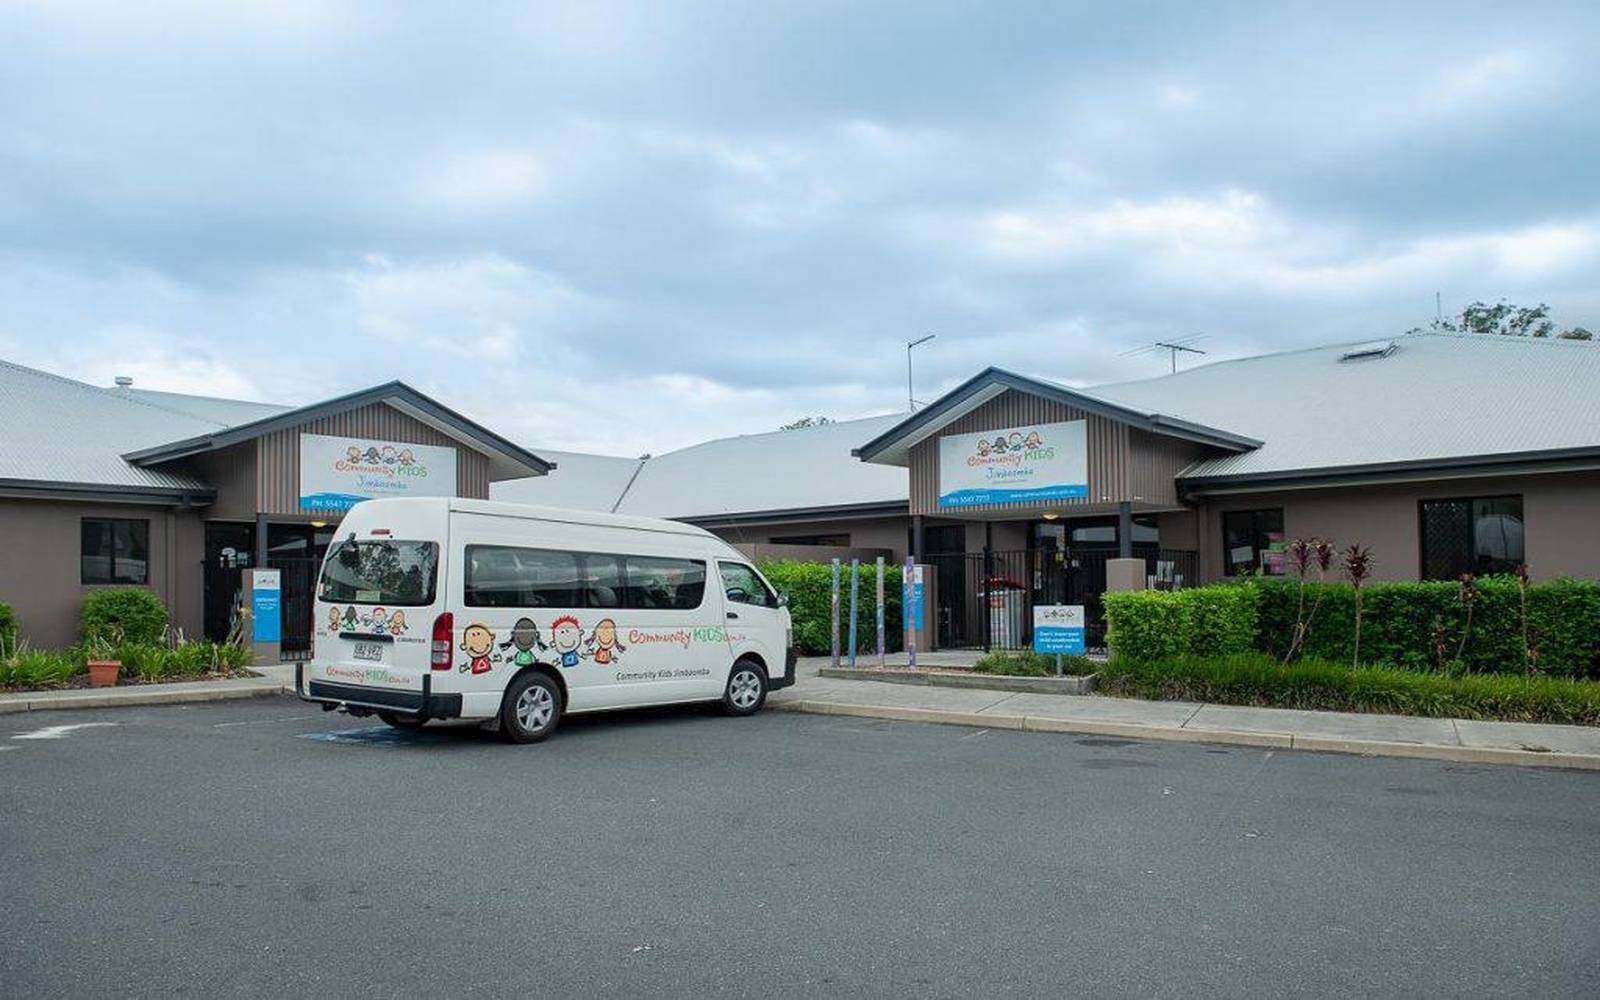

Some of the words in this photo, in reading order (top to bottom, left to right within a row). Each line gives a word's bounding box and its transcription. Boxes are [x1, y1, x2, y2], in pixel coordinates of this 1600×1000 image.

[967, 453, 1023, 468] Community
[1024, 447, 1056, 461] KIDS
[335, 460, 395, 479] Community
[397, 464, 428, 478] KIDS
[629, 629, 691, 649] Community
